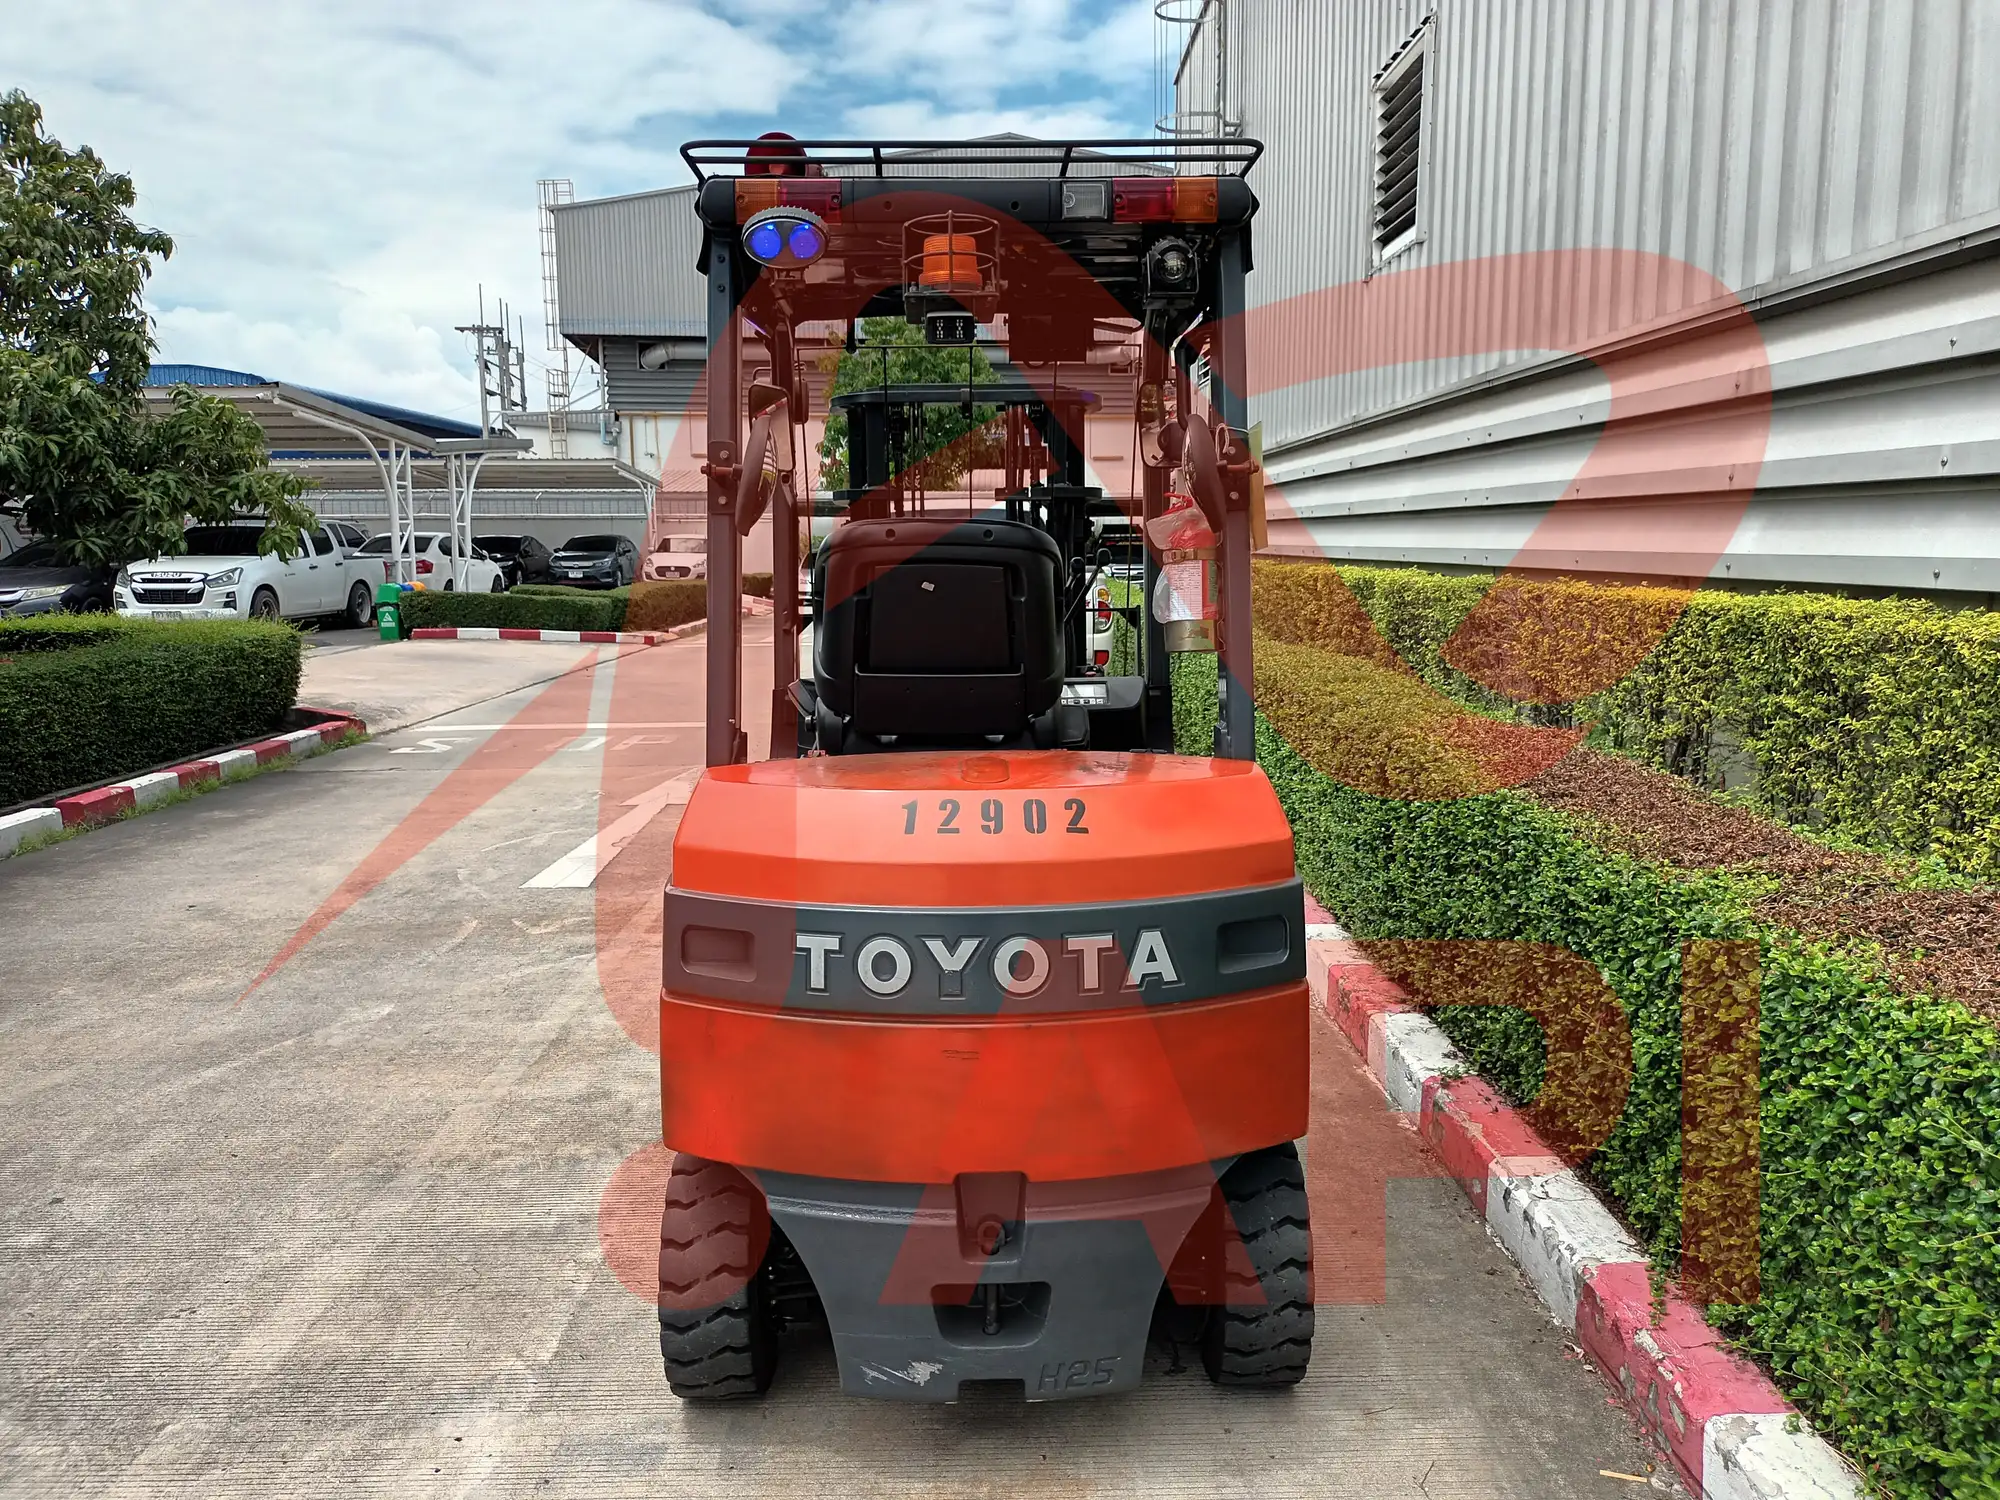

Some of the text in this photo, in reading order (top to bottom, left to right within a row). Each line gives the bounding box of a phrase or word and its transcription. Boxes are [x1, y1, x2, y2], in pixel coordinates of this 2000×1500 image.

[389, 735, 679, 753] SOP
[901, 798, 1089, 834] 12902
[794, 930, 1184, 998] TOYOTA
[1038, 1355, 1121, 1392] H25
